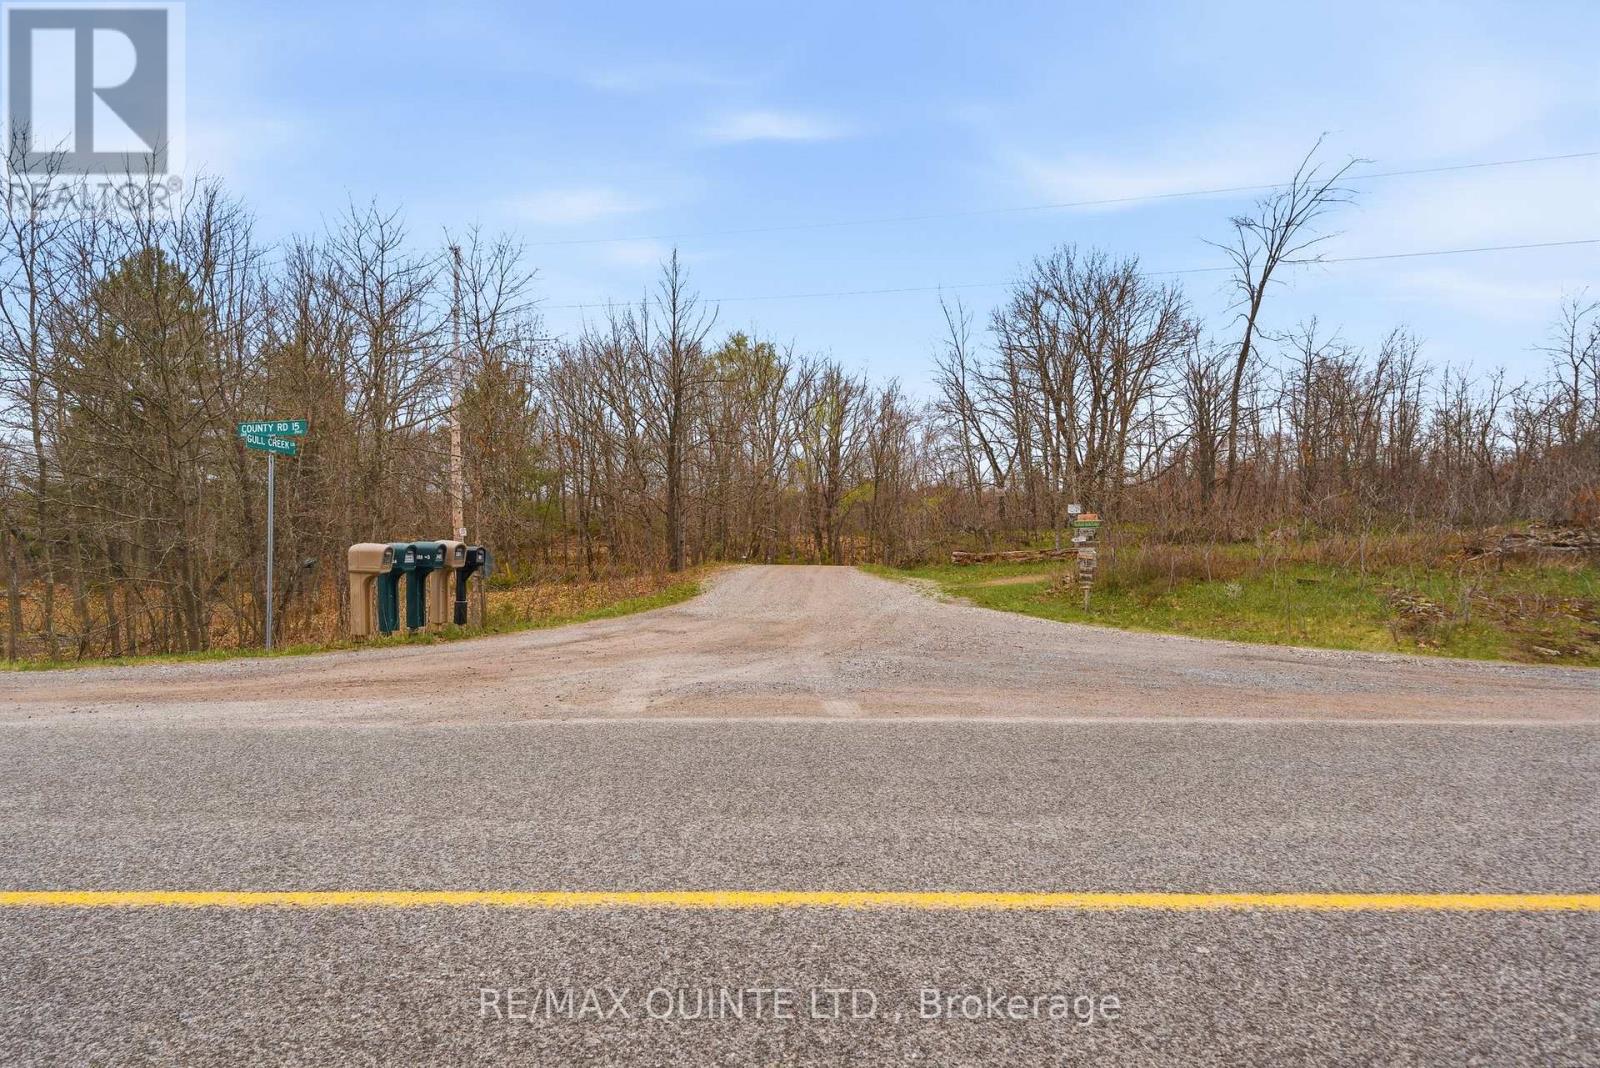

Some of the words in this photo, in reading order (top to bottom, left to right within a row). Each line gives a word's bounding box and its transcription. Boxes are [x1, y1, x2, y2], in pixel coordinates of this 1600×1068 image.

[241, 423, 273, 433] COUNTY
[277, 423, 288, 432] RD
[292, 422, 300, 431] 15
[268, 438, 290, 449] CREEK
